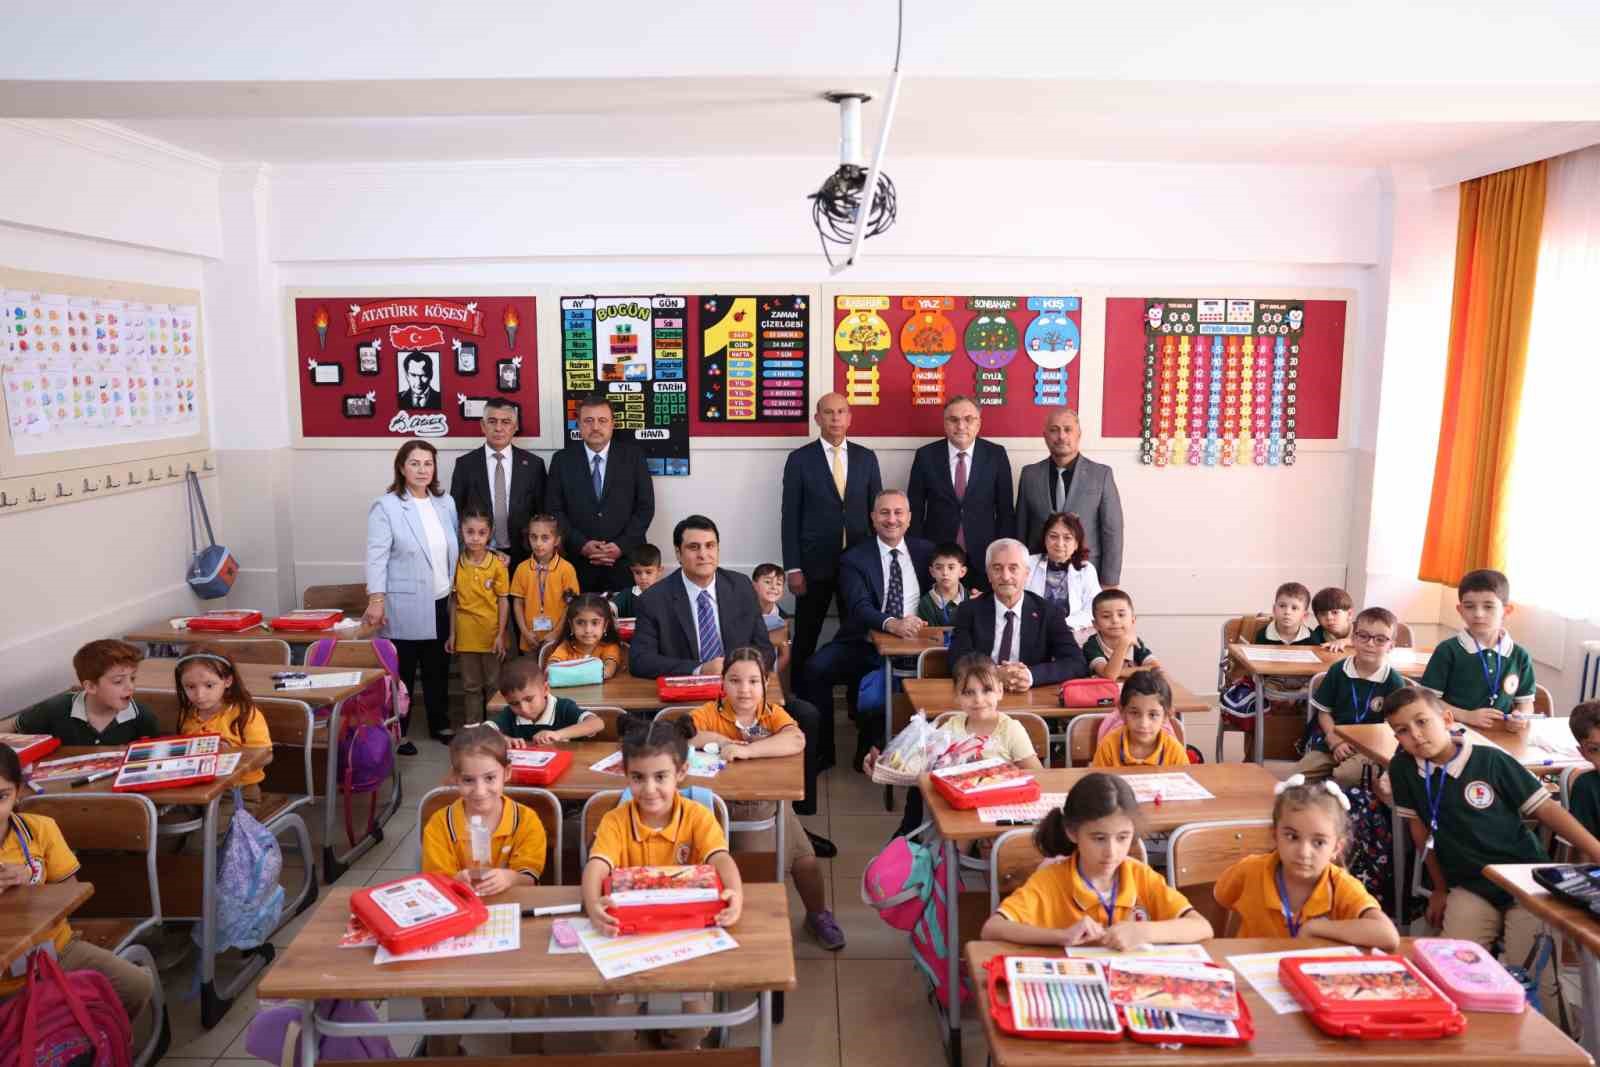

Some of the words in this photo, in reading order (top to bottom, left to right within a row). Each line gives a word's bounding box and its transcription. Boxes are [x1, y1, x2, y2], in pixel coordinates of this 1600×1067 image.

[659, 300, 678, 308] GÜN
[919, 300, 940, 309] YAZ
[975, 301, 1011, 309] SONBAHAR
[1043, 301, 1065, 310] KIŞ
[361, 304, 418, 322] ATATÜRK
[424, 304, 468, 321] KÖŞESİ
[597, 303, 650, 321] BUGÜN
[771, 311, 798, 319] ZAMAN
[761, 320, 803, 329] ÇİZELGESİ
[982, 373, 1003, 381] EYLÜL
[618, 384, 632, 392] YIL
[657, 383, 682, 391] TARİH
[641, 431, 664, 439] HAVA
